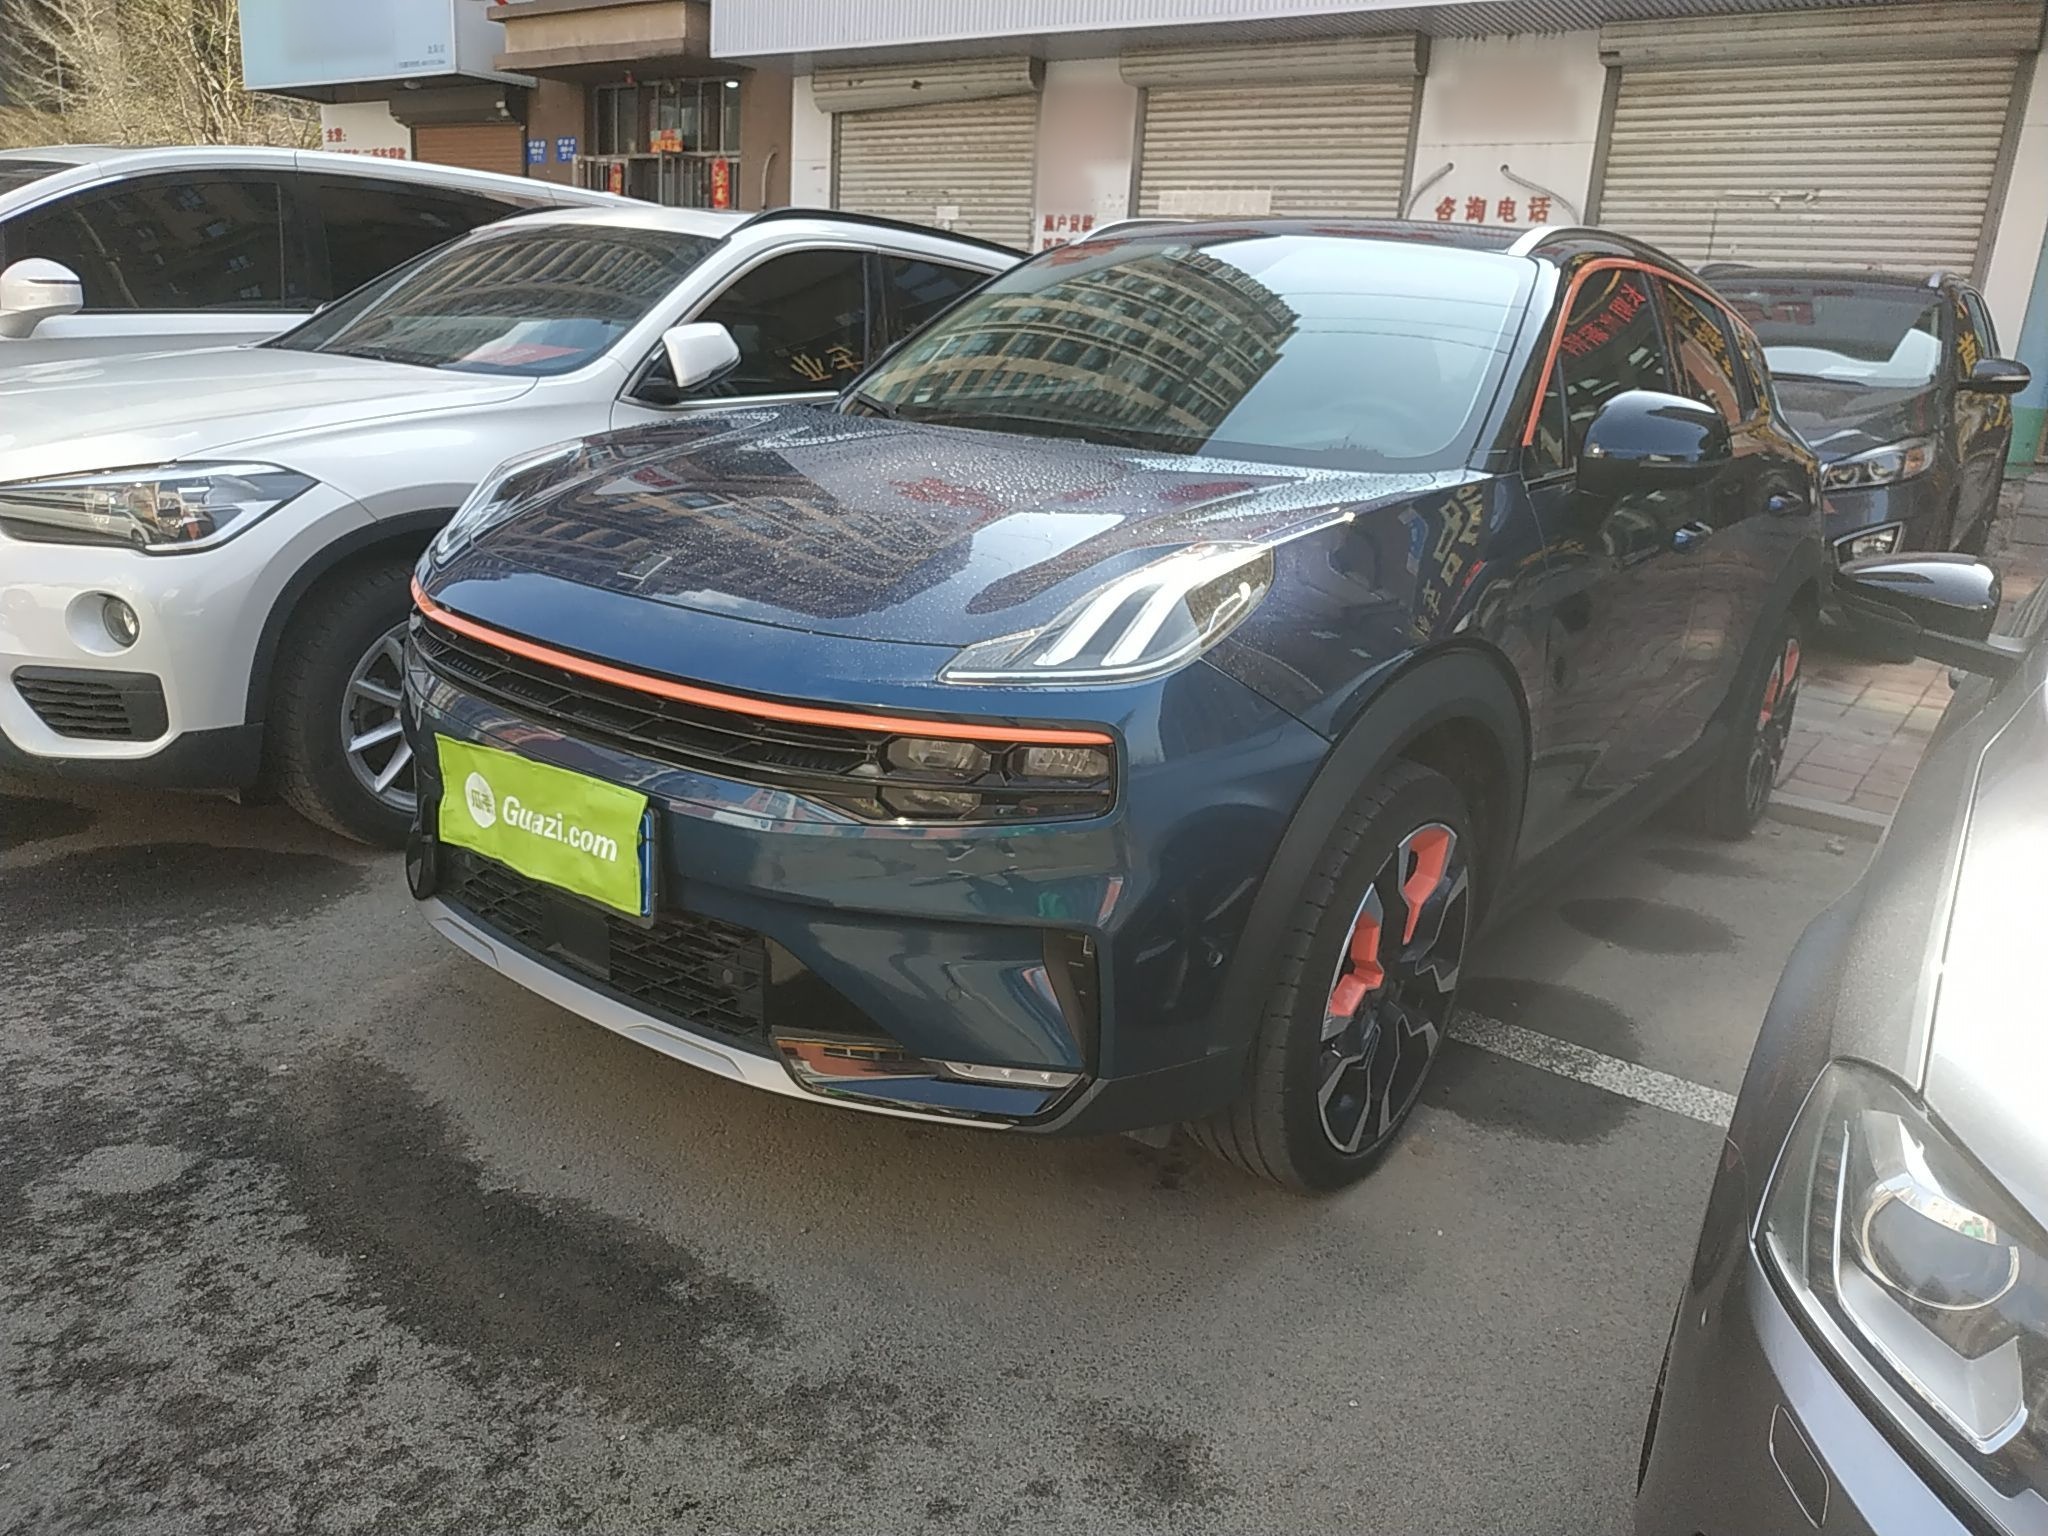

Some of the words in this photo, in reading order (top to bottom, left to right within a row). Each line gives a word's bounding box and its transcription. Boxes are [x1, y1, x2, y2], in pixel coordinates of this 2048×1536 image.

[1435, 196, 1551, 223] 咨询电话
[503, 796, 618, 862] Guazi.com
